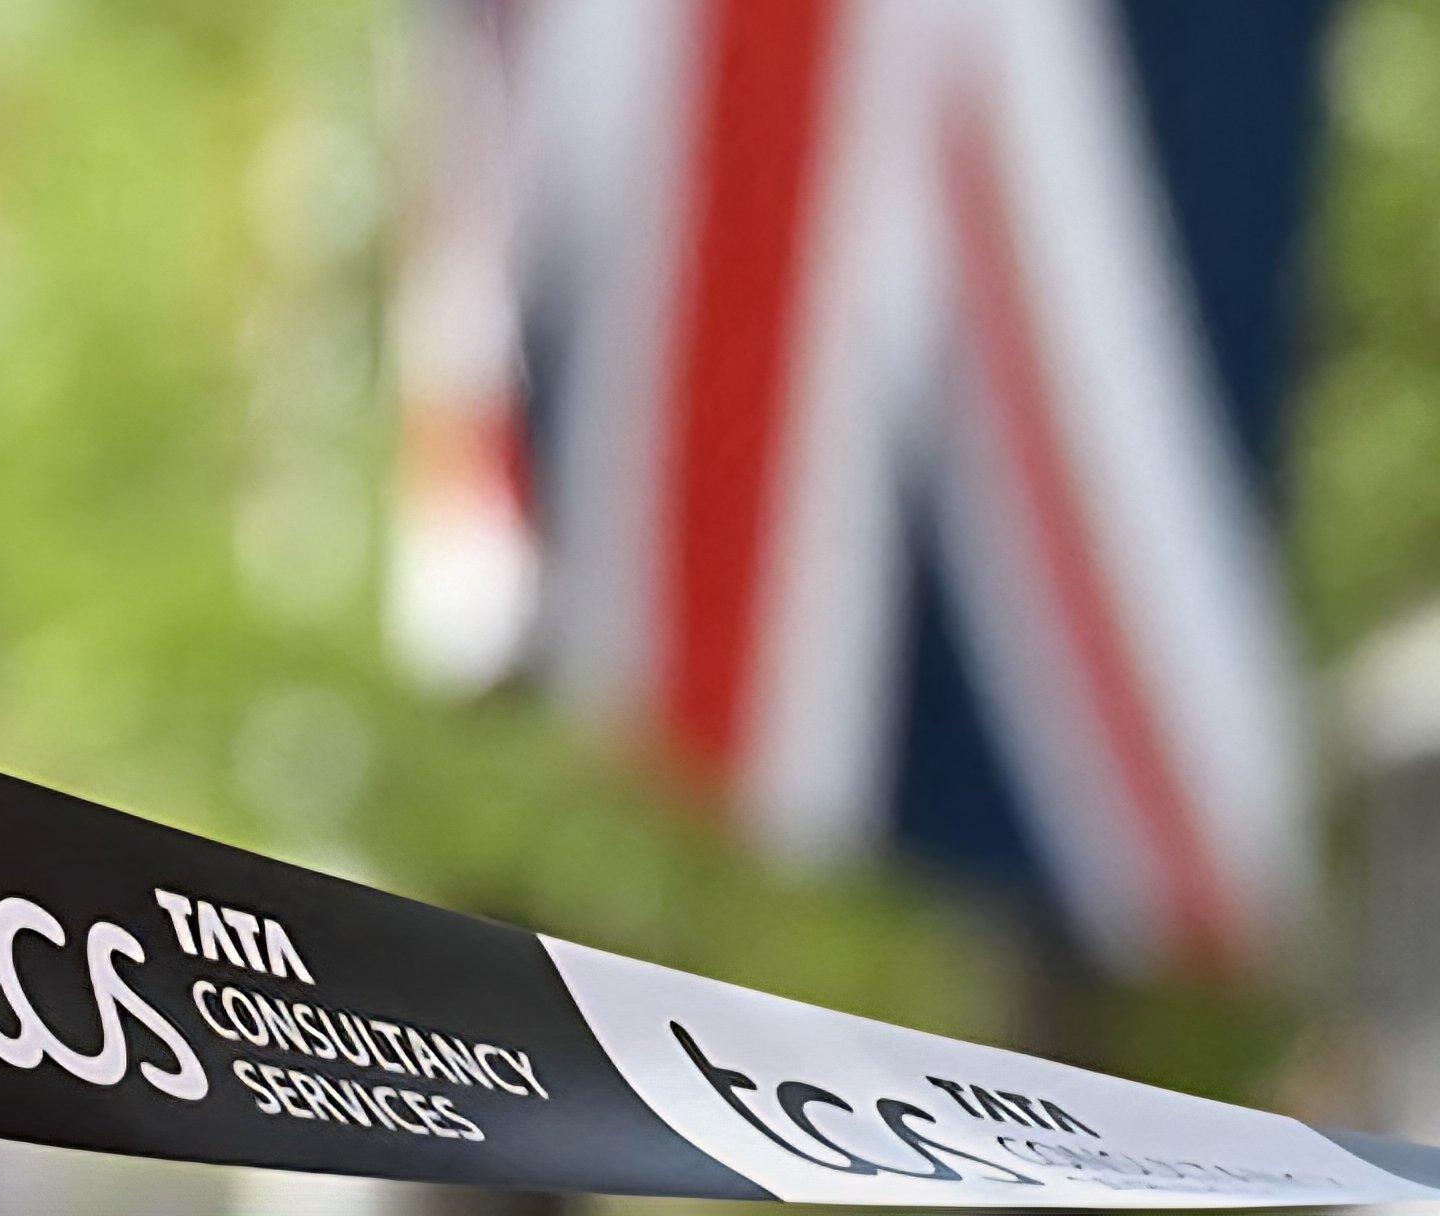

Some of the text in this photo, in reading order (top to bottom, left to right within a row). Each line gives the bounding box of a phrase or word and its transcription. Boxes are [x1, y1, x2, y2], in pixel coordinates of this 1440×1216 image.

[154, 887, 316, 984] TATA
[192, 980, 549, 1100] CONSULTANCY
[232, 1059, 486, 1142] SERVICES
[669, 1019, 1045, 1186] tcs
[925, 1075, 1102, 1138] TATA
